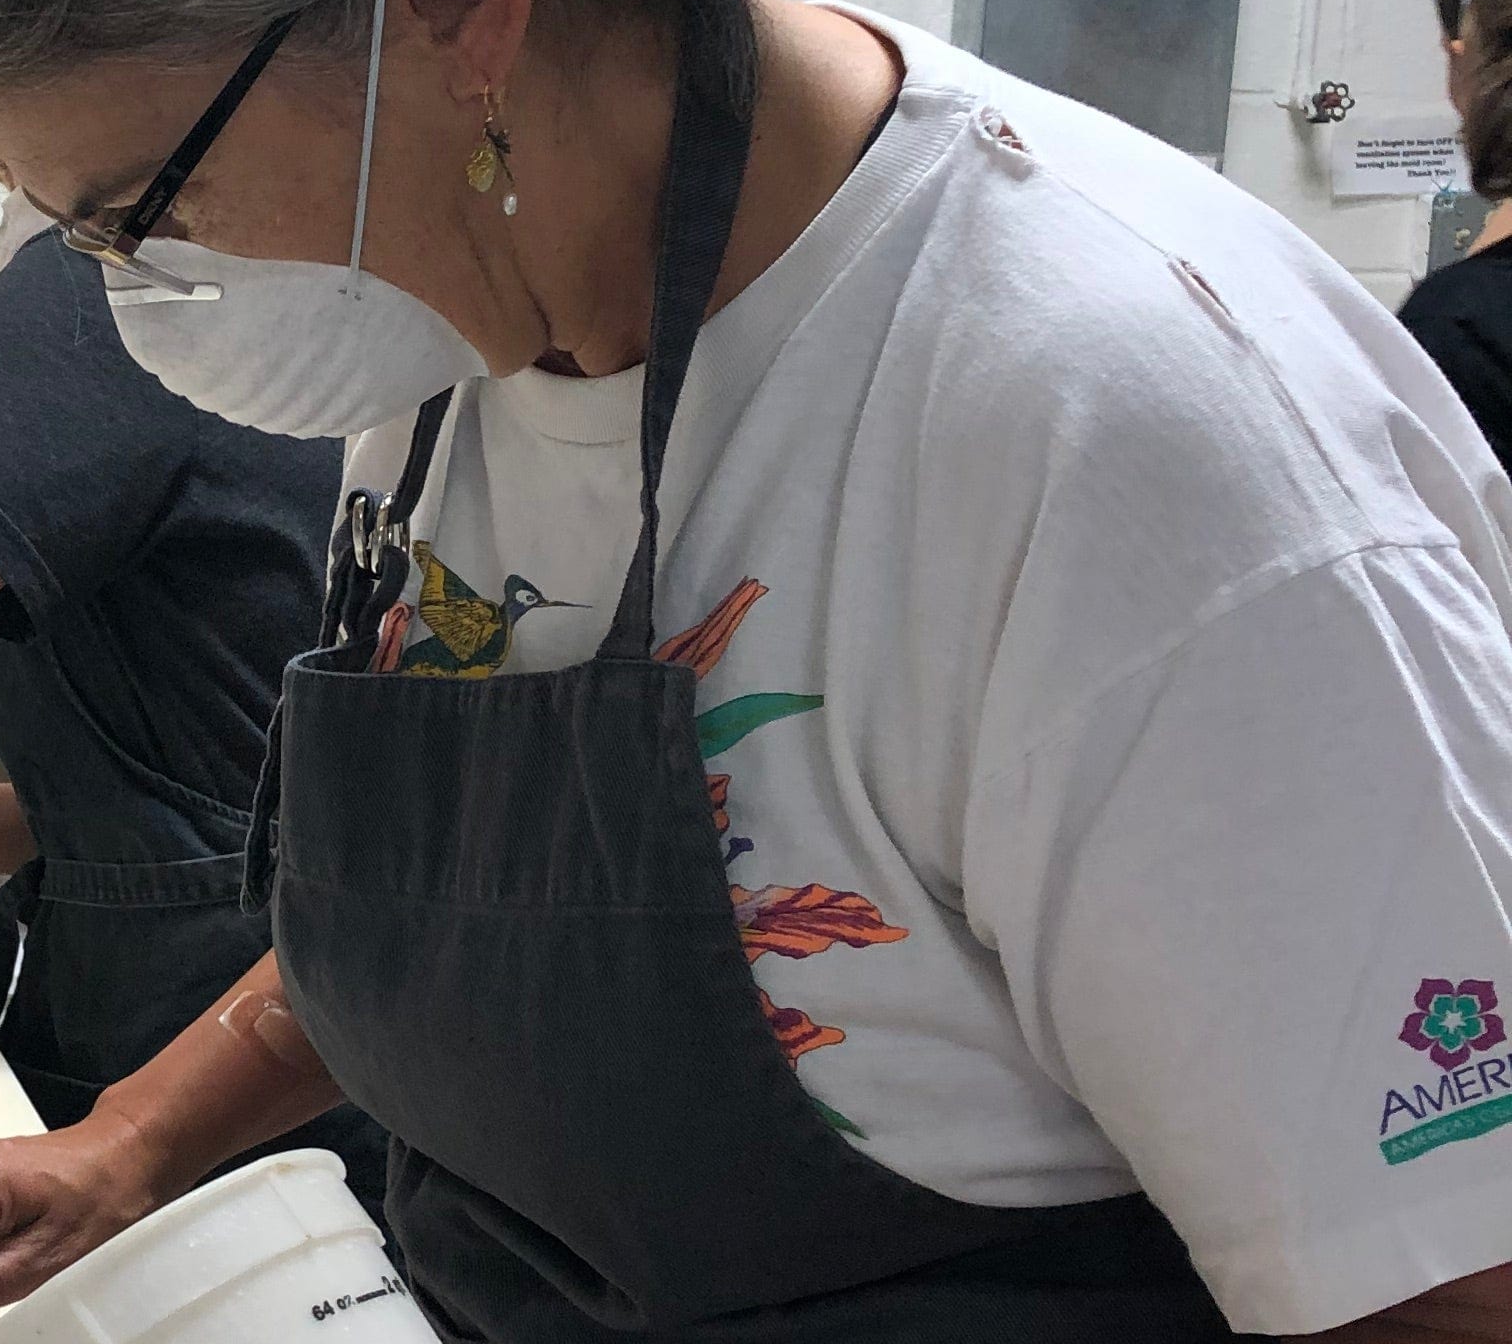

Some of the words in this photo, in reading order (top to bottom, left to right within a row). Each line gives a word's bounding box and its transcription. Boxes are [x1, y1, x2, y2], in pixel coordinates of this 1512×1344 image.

[1381, 140, 1405, 148] forget
[1435, 137, 1453, 145] OFF
[1355, 161, 1385, 169] leaving
[311, 1300, 336, 1321] 64
